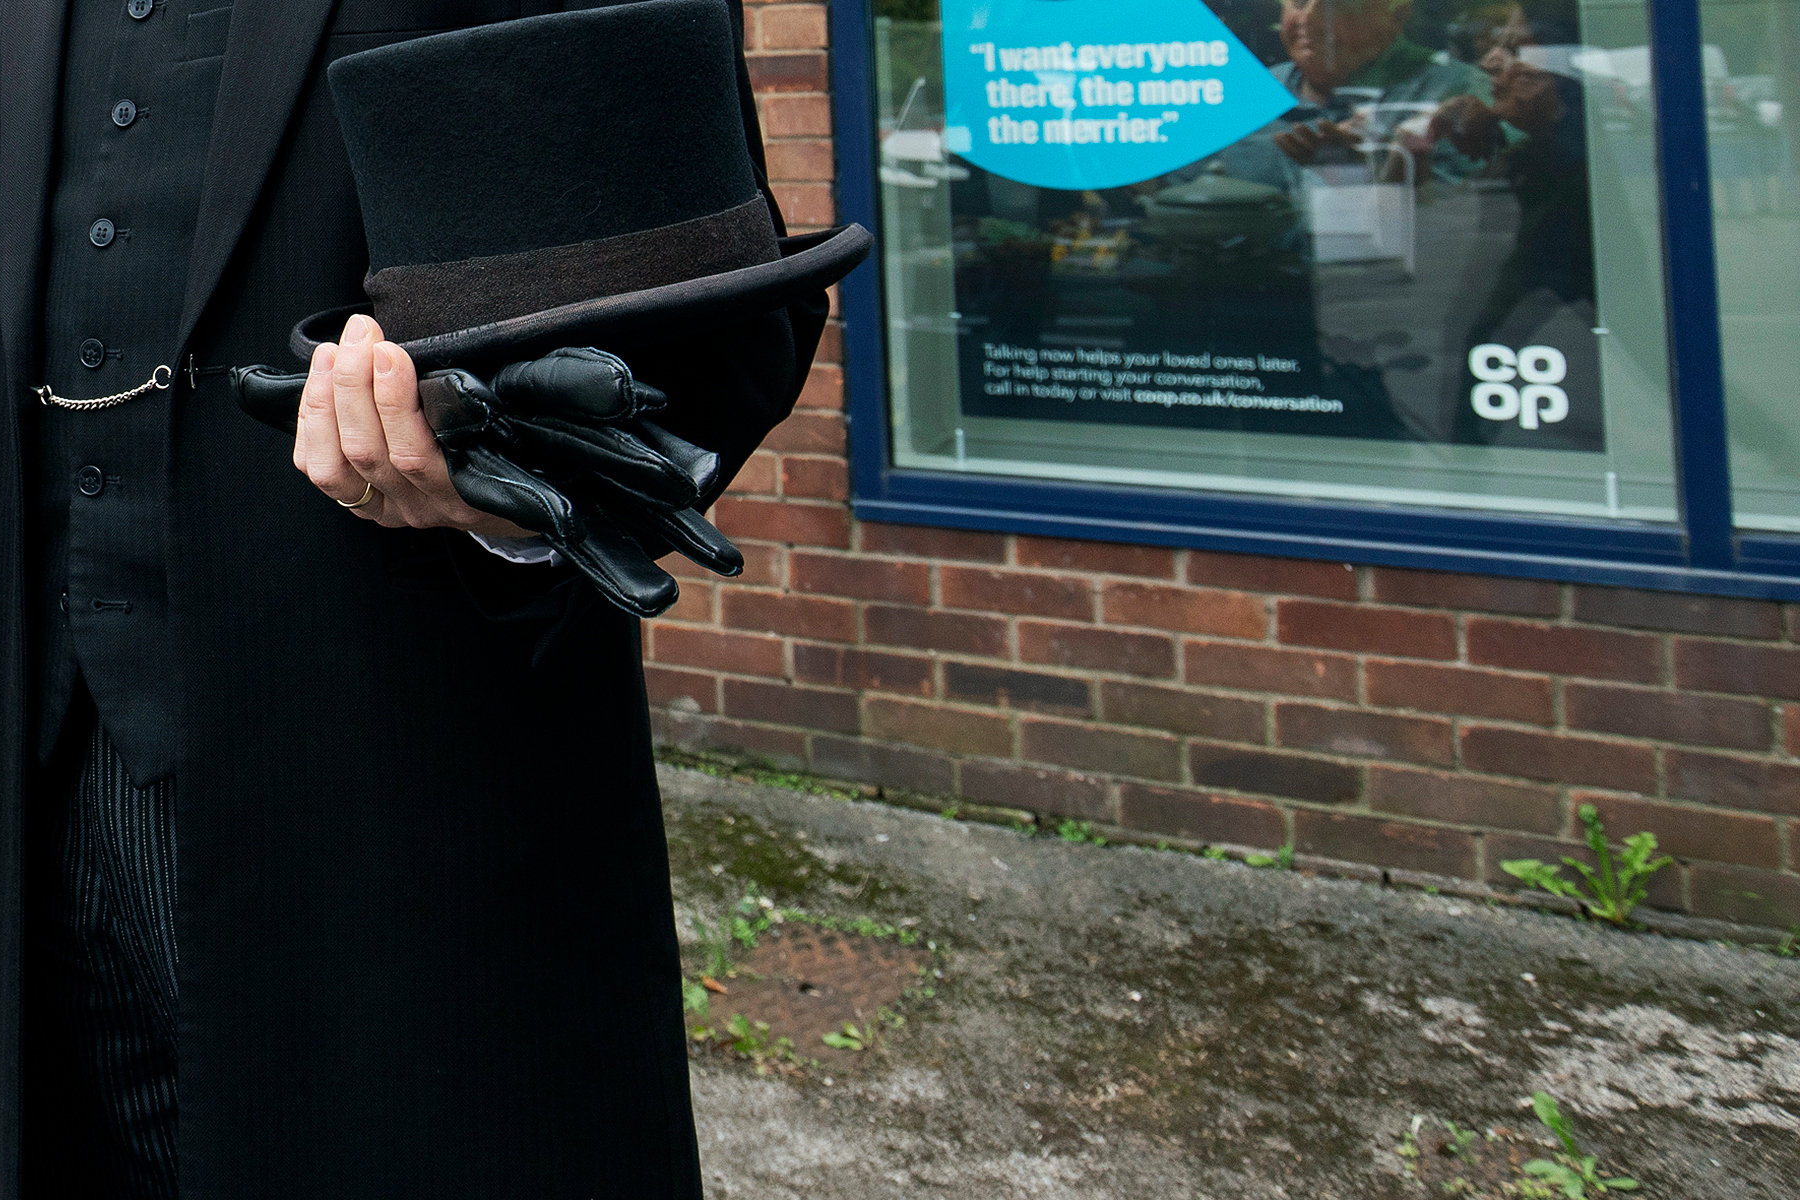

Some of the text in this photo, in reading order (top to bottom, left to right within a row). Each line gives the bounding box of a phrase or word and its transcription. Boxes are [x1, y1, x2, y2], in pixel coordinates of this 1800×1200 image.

[999, 41, 1075, 72] want
[1077, 40, 1229, 73] everyone
[1079, 75, 1135, 107] the
[1138, 78, 1225, 106] more
[987, 114, 1039, 144] the
[983, 343, 1038, 365] Talking
[1039, 349, 1075, 363] now
[1076, 347, 1122, 367] helps
[1122, 352, 1161, 369] your
[1163, 351, 1211, 368] loved
[1212, 356, 1257, 371] ones
[983, 360, 1011, 378] For
[1012, 362, 1050, 382] help
[1050, 367, 1113, 387] starting
[1113, 370, 1151, 387] your
[984, 379, 1344, 413] call in today or visit coop.co.uk/conversation
